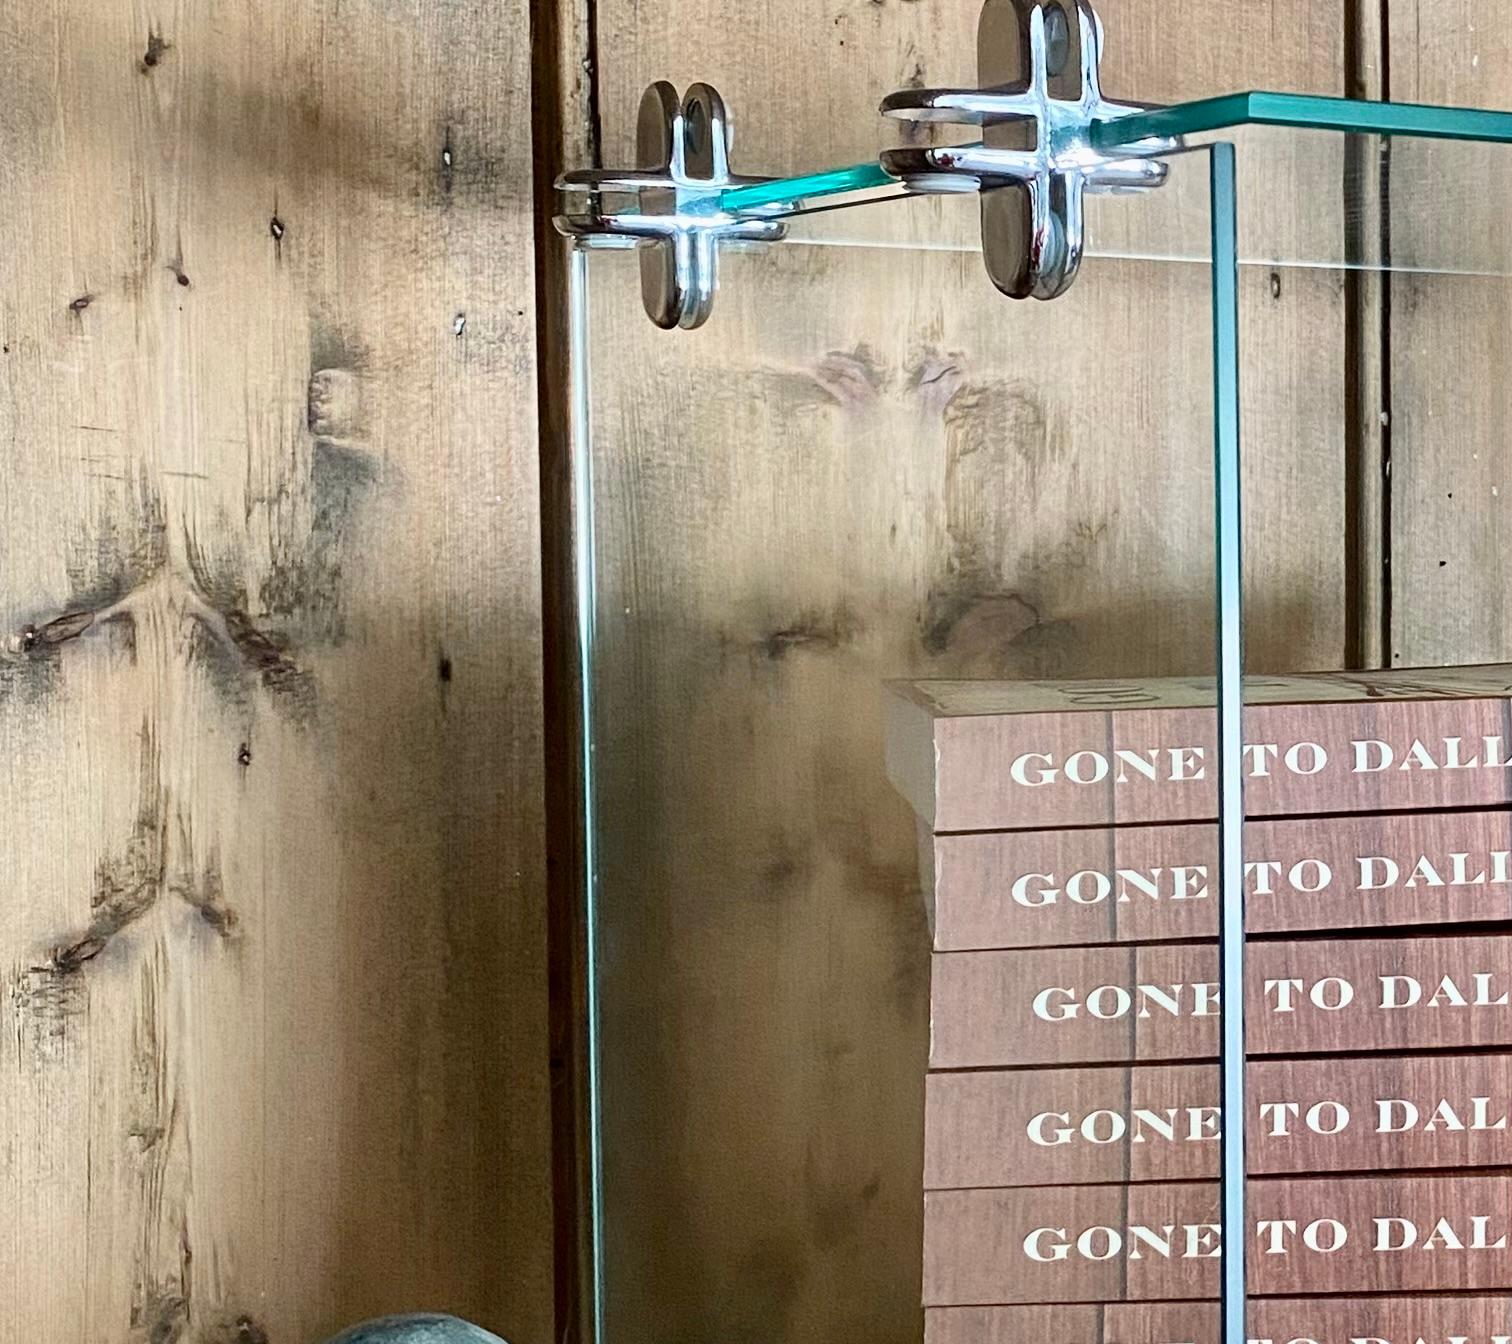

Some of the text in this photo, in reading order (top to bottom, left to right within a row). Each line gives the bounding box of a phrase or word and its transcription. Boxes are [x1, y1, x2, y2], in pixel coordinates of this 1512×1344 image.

[1011, 748, 1204, 786] GONE
[1243, 743, 1327, 776] TO
[1012, 867, 1207, 906] GONE
[1245, 860, 1331, 894] TO
[1265, 978, 1353, 1011] TO
[1027, 1107, 1221, 1146] GONE
[1260, 1102, 1349, 1136] TO
[1024, 1224, 1221, 1261] GONE
[1258, 1219, 1347, 1253] TO
